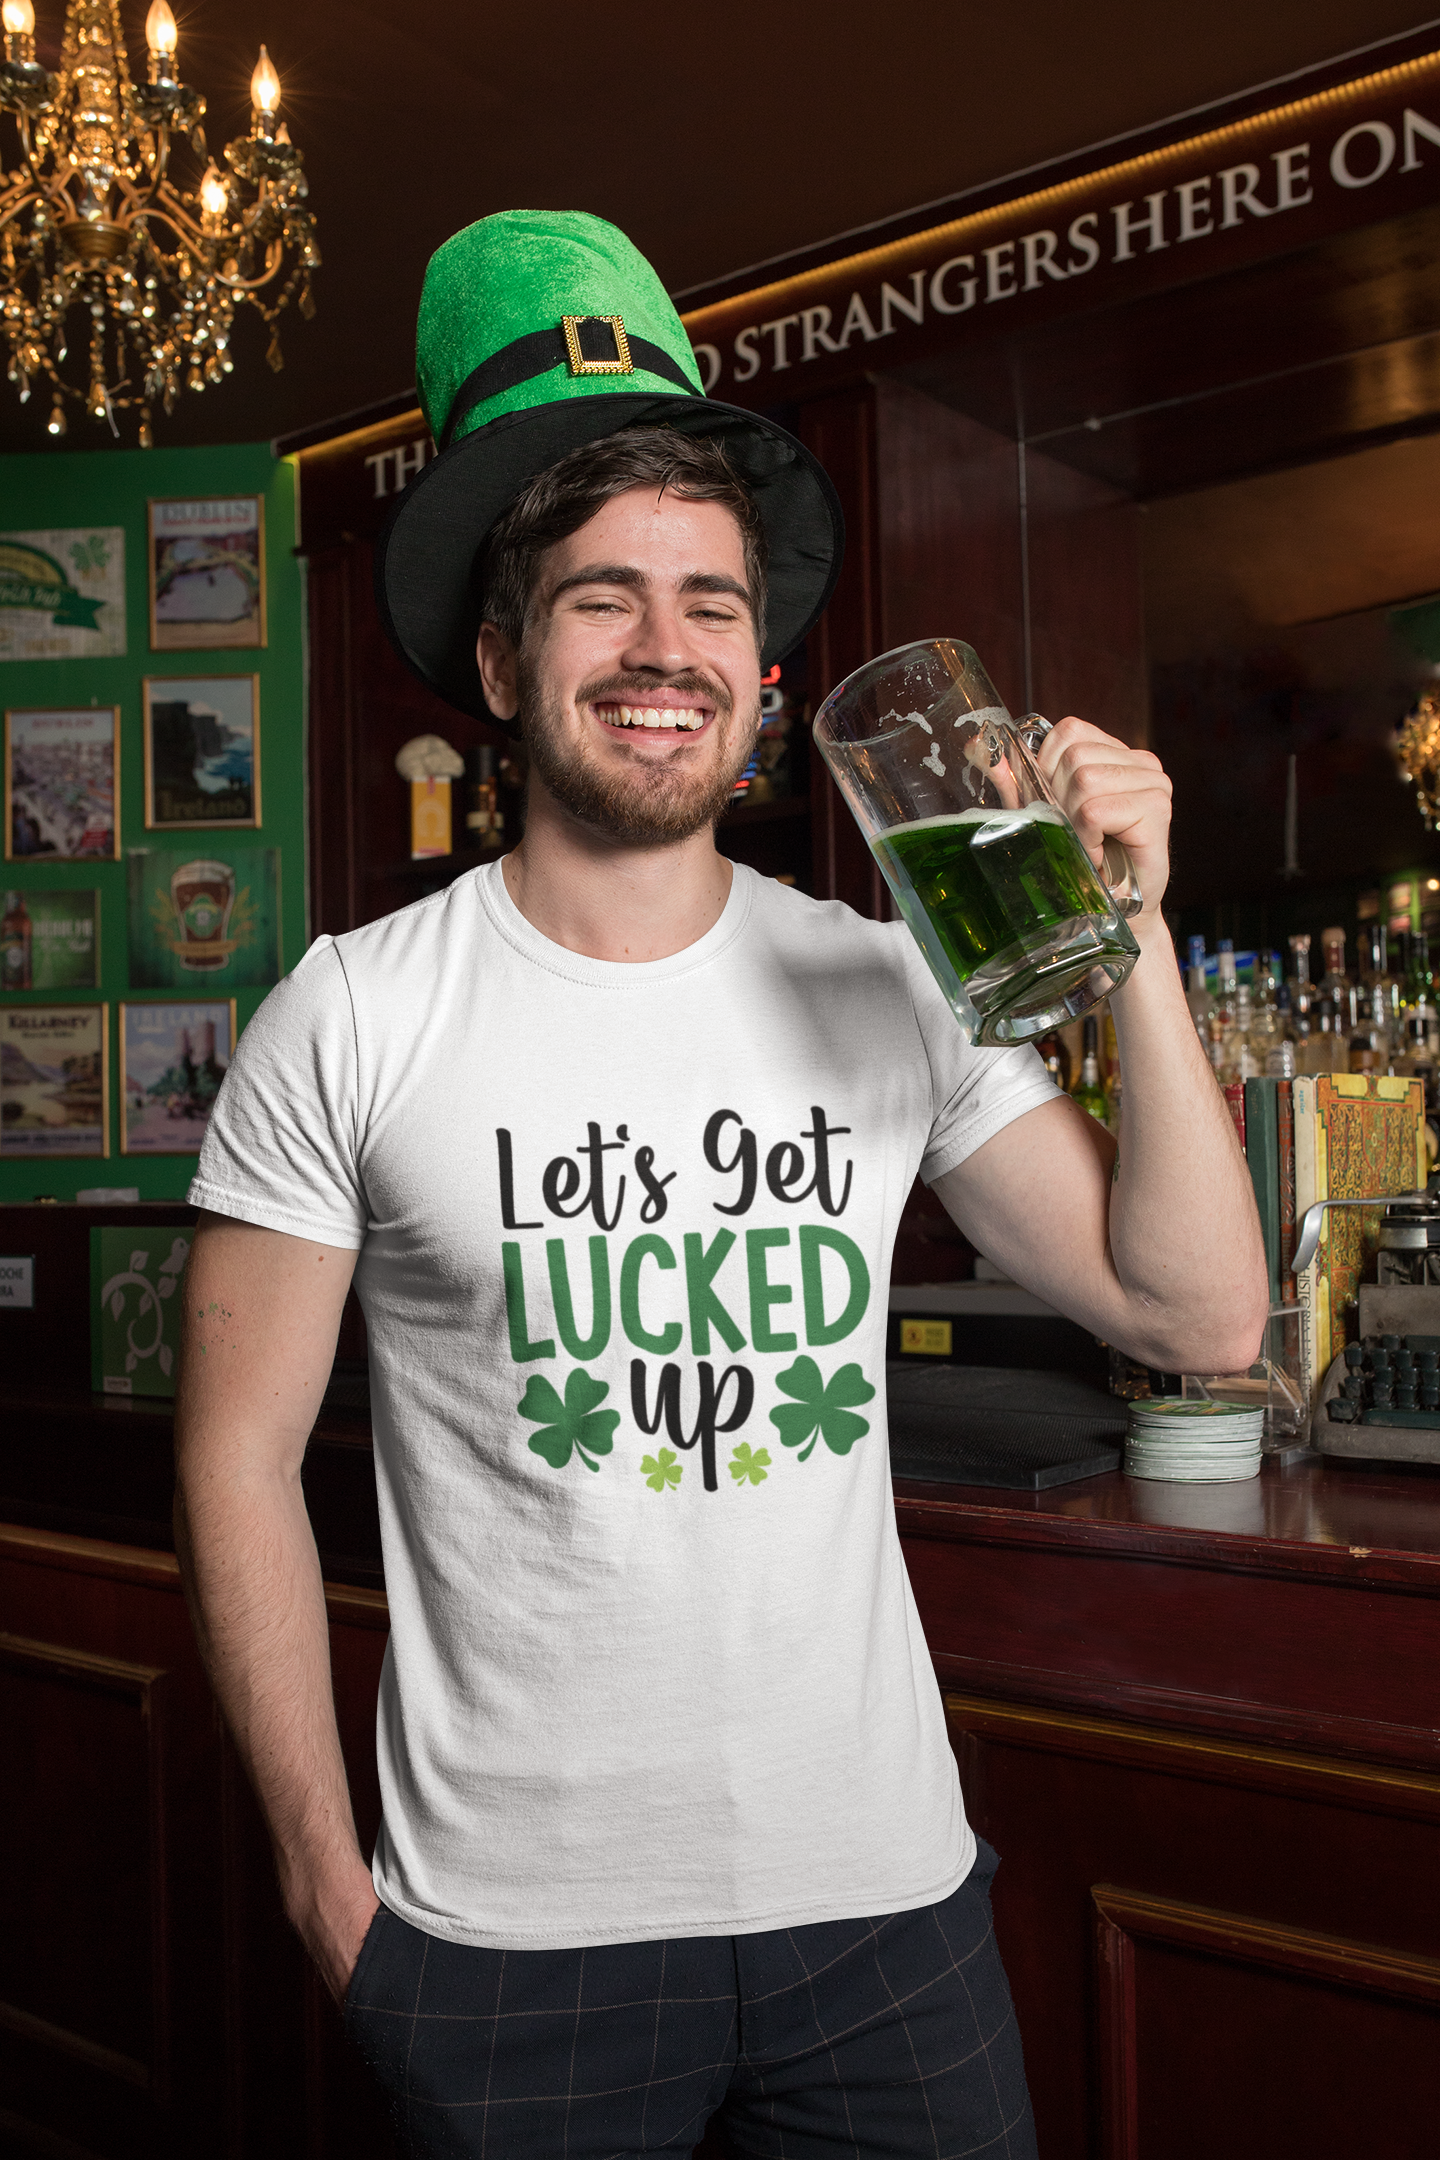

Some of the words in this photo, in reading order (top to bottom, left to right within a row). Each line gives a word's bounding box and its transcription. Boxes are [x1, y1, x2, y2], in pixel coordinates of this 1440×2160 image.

[733, 212, 1101, 383] STRANGERS
[1110, 143, 1315, 264] HERE
[496, 1120, 678, 1232] Let's
[703, 1105, 853, 1217] get
[501, 1224, 871, 1364] LUCKED
[630, 1358, 755, 1492] up
